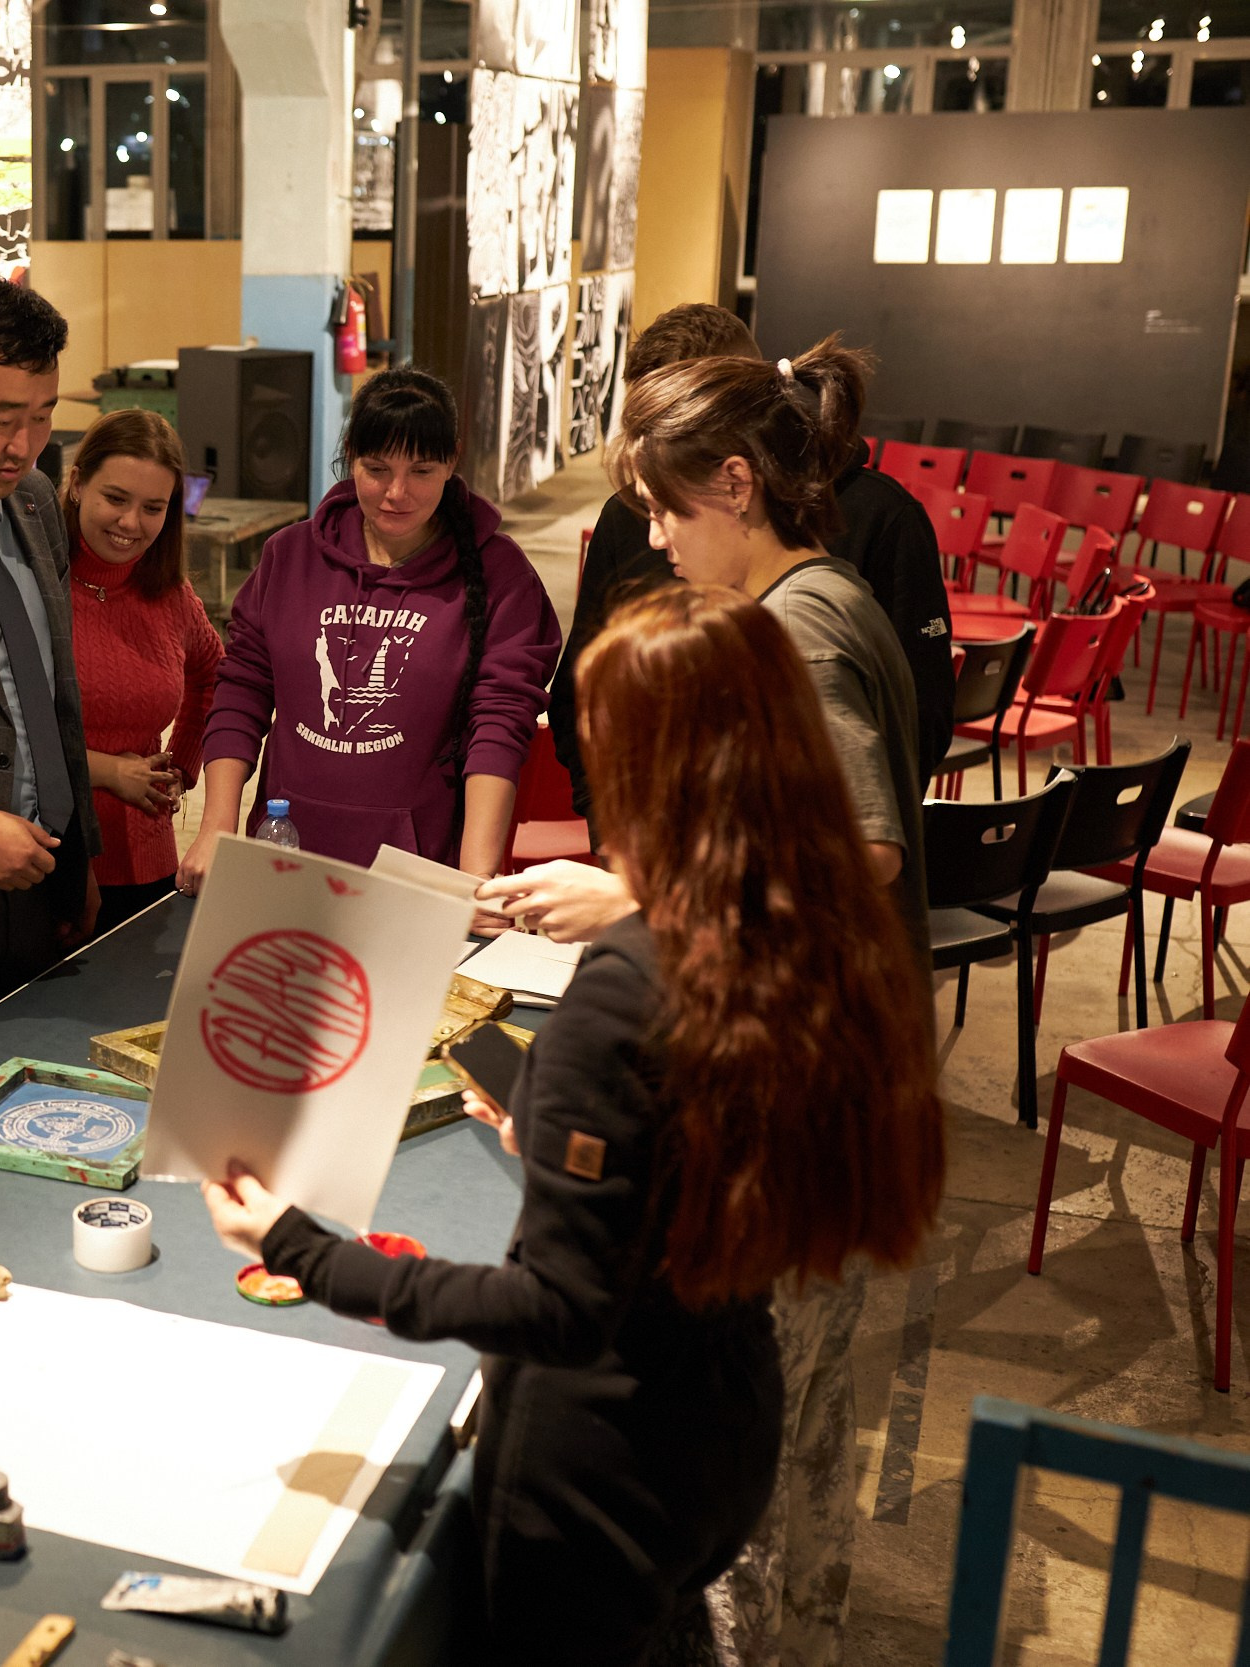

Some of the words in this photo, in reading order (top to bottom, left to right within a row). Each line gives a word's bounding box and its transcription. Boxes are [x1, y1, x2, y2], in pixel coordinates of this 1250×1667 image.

[320, 604, 428, 633] САХАЛИН
[296, 722, 353, 754] SAKHALIN
[356, 731, 405, 754] REGION
